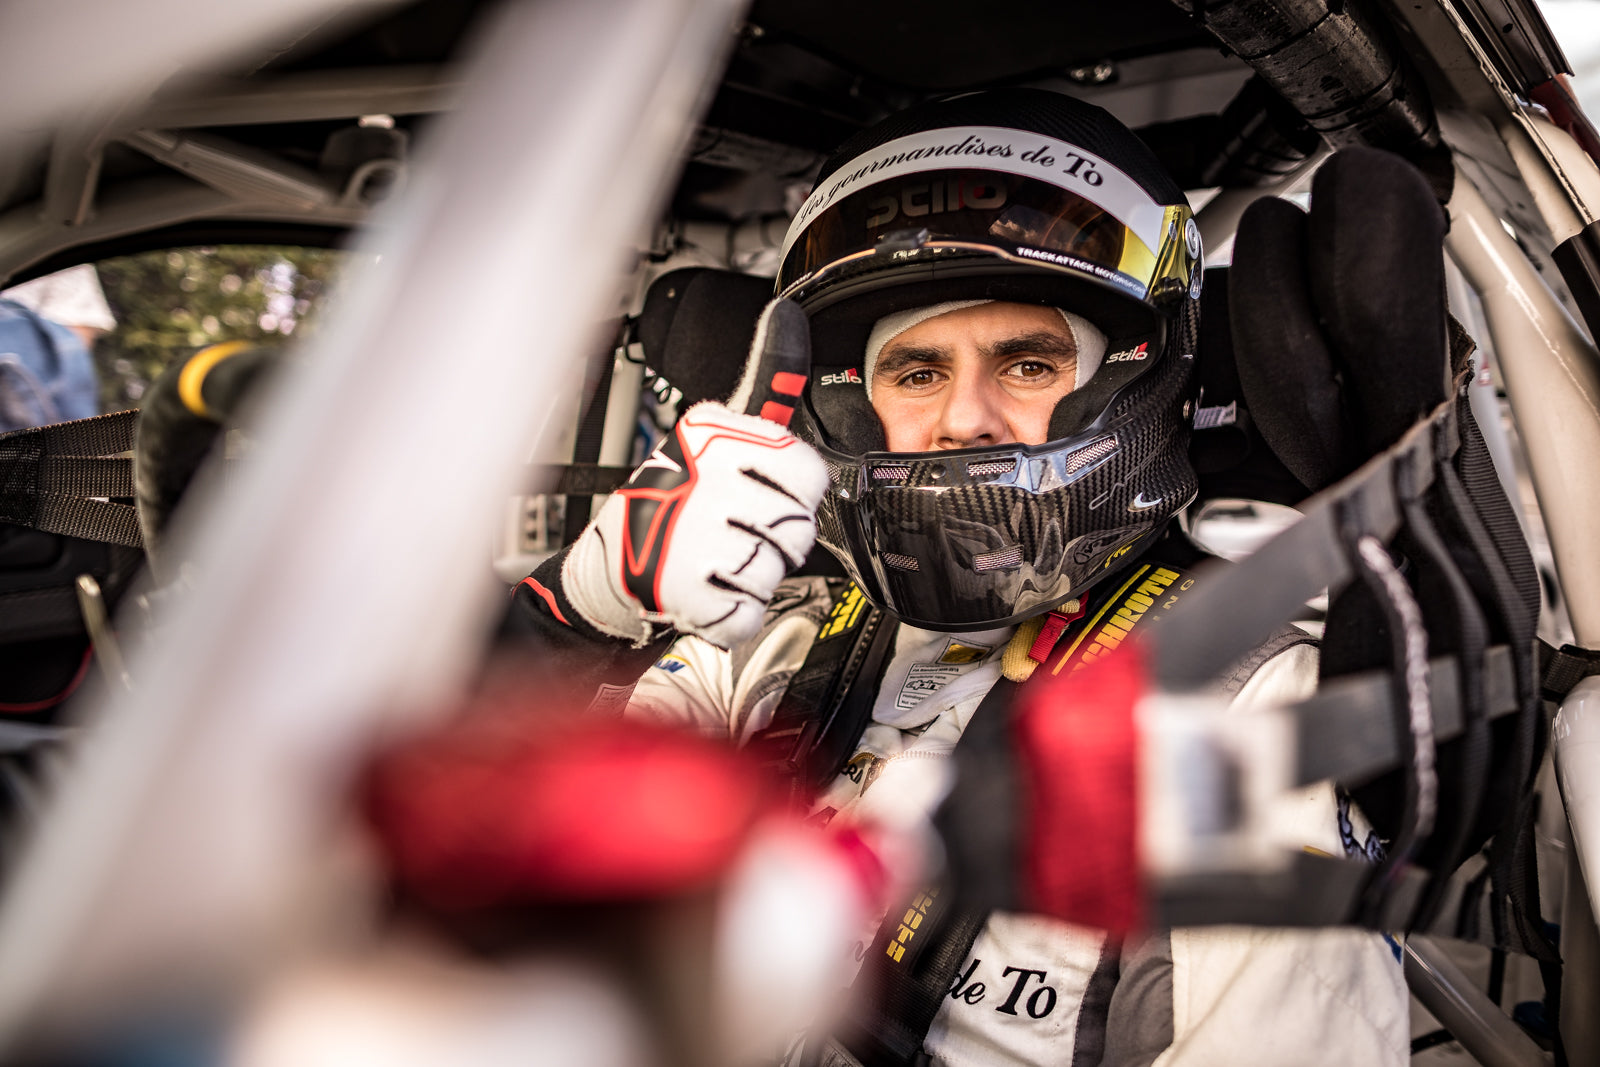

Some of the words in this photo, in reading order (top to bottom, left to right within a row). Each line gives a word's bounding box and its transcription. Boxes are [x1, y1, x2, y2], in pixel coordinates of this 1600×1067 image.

[821, 135, 1014, 209] gourmandises
[1020, 145, 1056, 167] de
[1062, 151, 1104, 187] To
[1105, 342, 1149, 364] stilo
[820, 367, 862, 386] stilo
[995, 965, 1058, 1020] To
